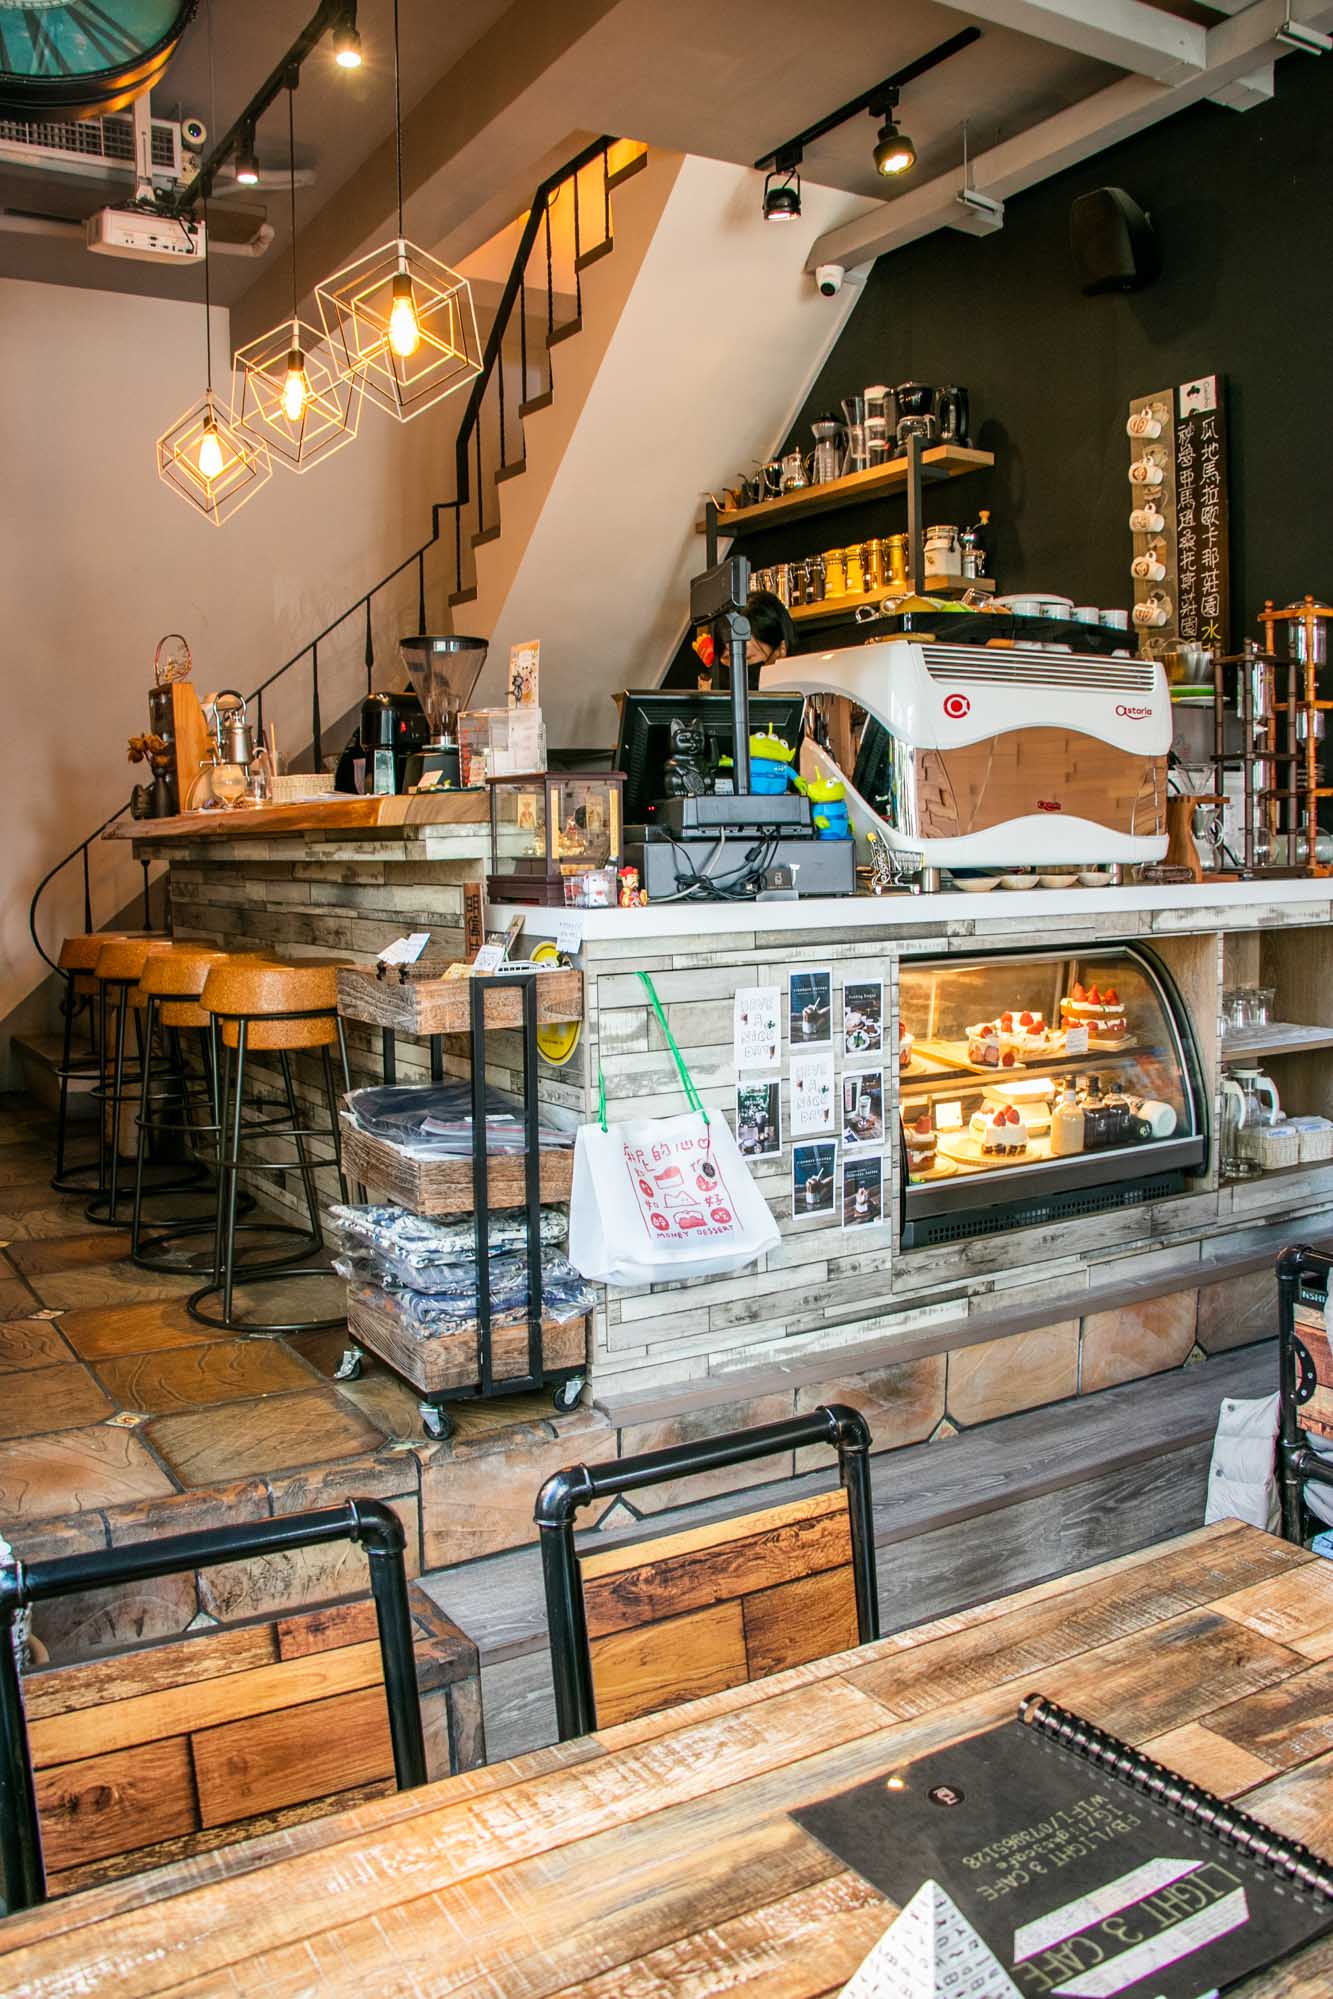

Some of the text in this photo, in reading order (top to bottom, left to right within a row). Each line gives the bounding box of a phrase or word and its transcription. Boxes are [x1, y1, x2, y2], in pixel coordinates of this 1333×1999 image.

[1028, 1859, 1049, 1875] 3
[976, 1870, 1028, 1902] CAFE
[1141, 1862, 1242, 1928] LIGHT
[1103, 1916, 1142, 1947] 3
[1011, 1936, 1103, 1993] CAFE
